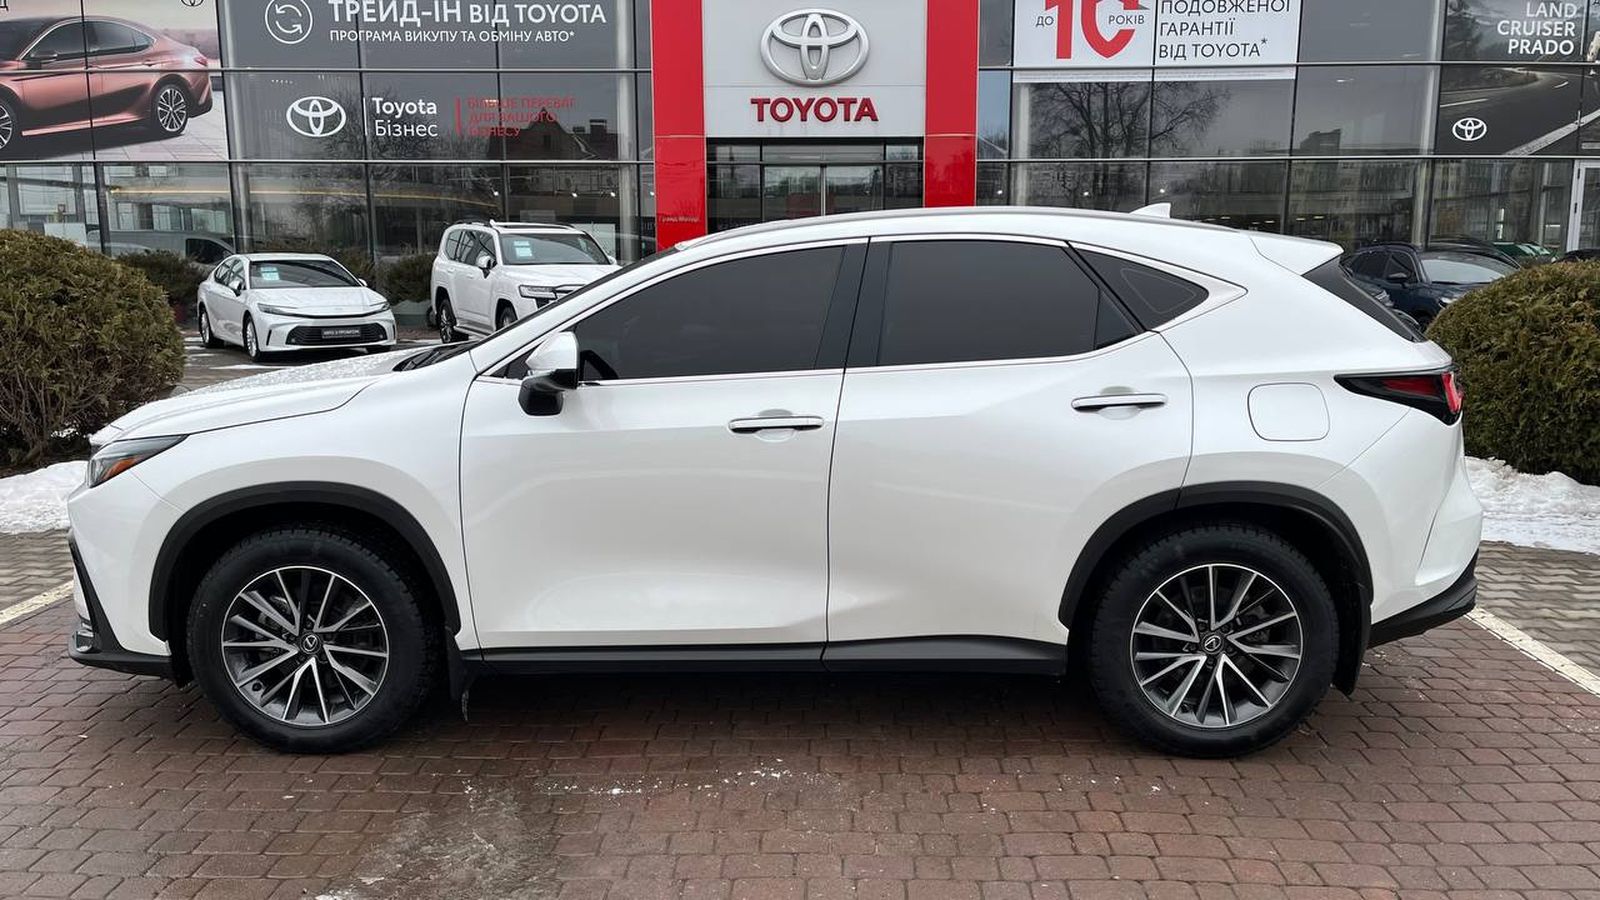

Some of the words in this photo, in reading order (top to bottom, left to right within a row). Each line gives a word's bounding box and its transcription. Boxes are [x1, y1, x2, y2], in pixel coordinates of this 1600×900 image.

[469, 4, 510, 27] ВІД
[514, 4, 607, 23] TOYOTA
[1526, 2, 1577, 18] LAND
[1036, 16, 1054, 27] ДО
[1108, 15, 1145, 25] РОКІВ
[1160, 17, 1235, 36] ГАРАНТІЇ
[1497, 20, 1576, 37] CRUISER
[329, 30, 402, 42] ПРОГРАМА
[404, 30, 460, 42] ВИКУПУ
[461, 31, 476, 42] ТА
[479, 30, 532, 42] ОБМІНУ
[1159, 45, 1188, 60] ВІД
[1508, 39, 1574, 55] PRADO
[371, 97, 438, 118] Toyota
[750, 97, 879, 122] TOYOTA
[375, 120, 438, 137] Бізнес
